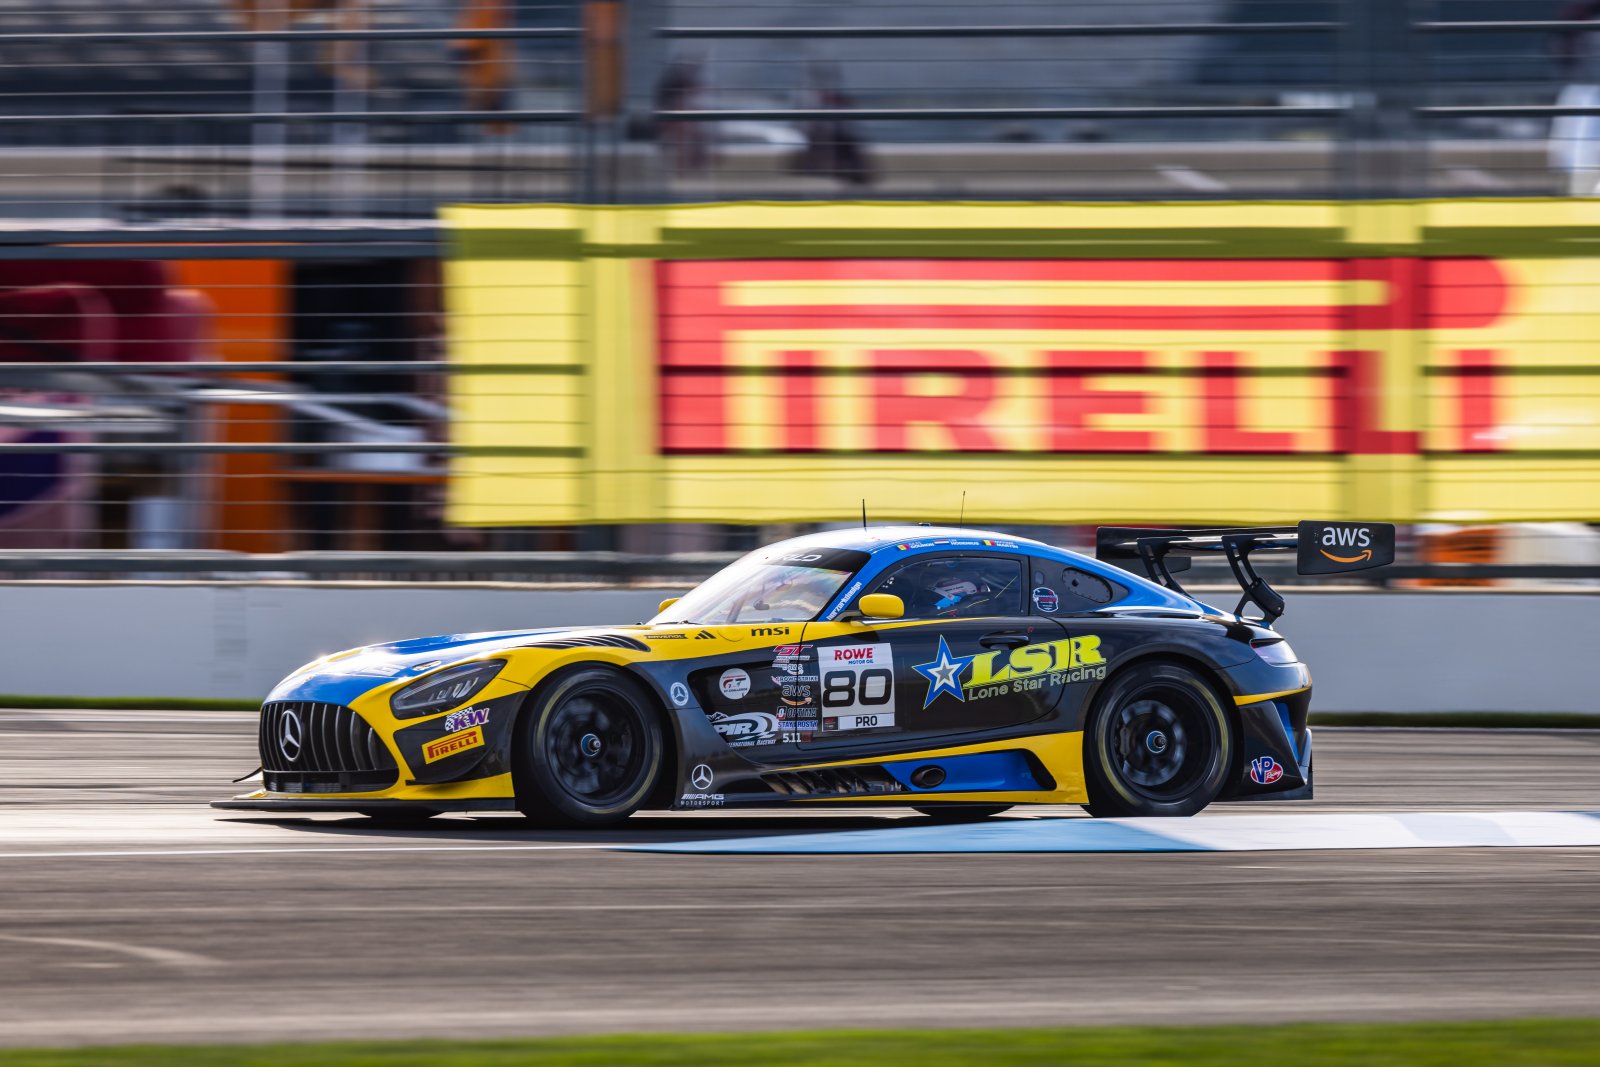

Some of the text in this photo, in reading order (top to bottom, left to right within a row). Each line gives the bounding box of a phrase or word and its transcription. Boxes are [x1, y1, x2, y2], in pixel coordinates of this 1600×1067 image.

[647, 257, 1518, 454] PIRELLI
[1322, 527, 1370, 547] aws
[752, 627, 790, 637] msi
[834, 648, 873, 660] ROWE
[962, 634, 1107, 688] LSR
[823, 668, 892, 708] 80
[968, 666, 1106, 701] Lone Star Racing
[452, 708, 490, 732] KW
[855, 715, 878, 727] PRO
[427, 731, 478, 759] PIRELLI
[782, 733, 801, 742] 5.11
[1251, 756, 1274, 784] VP
